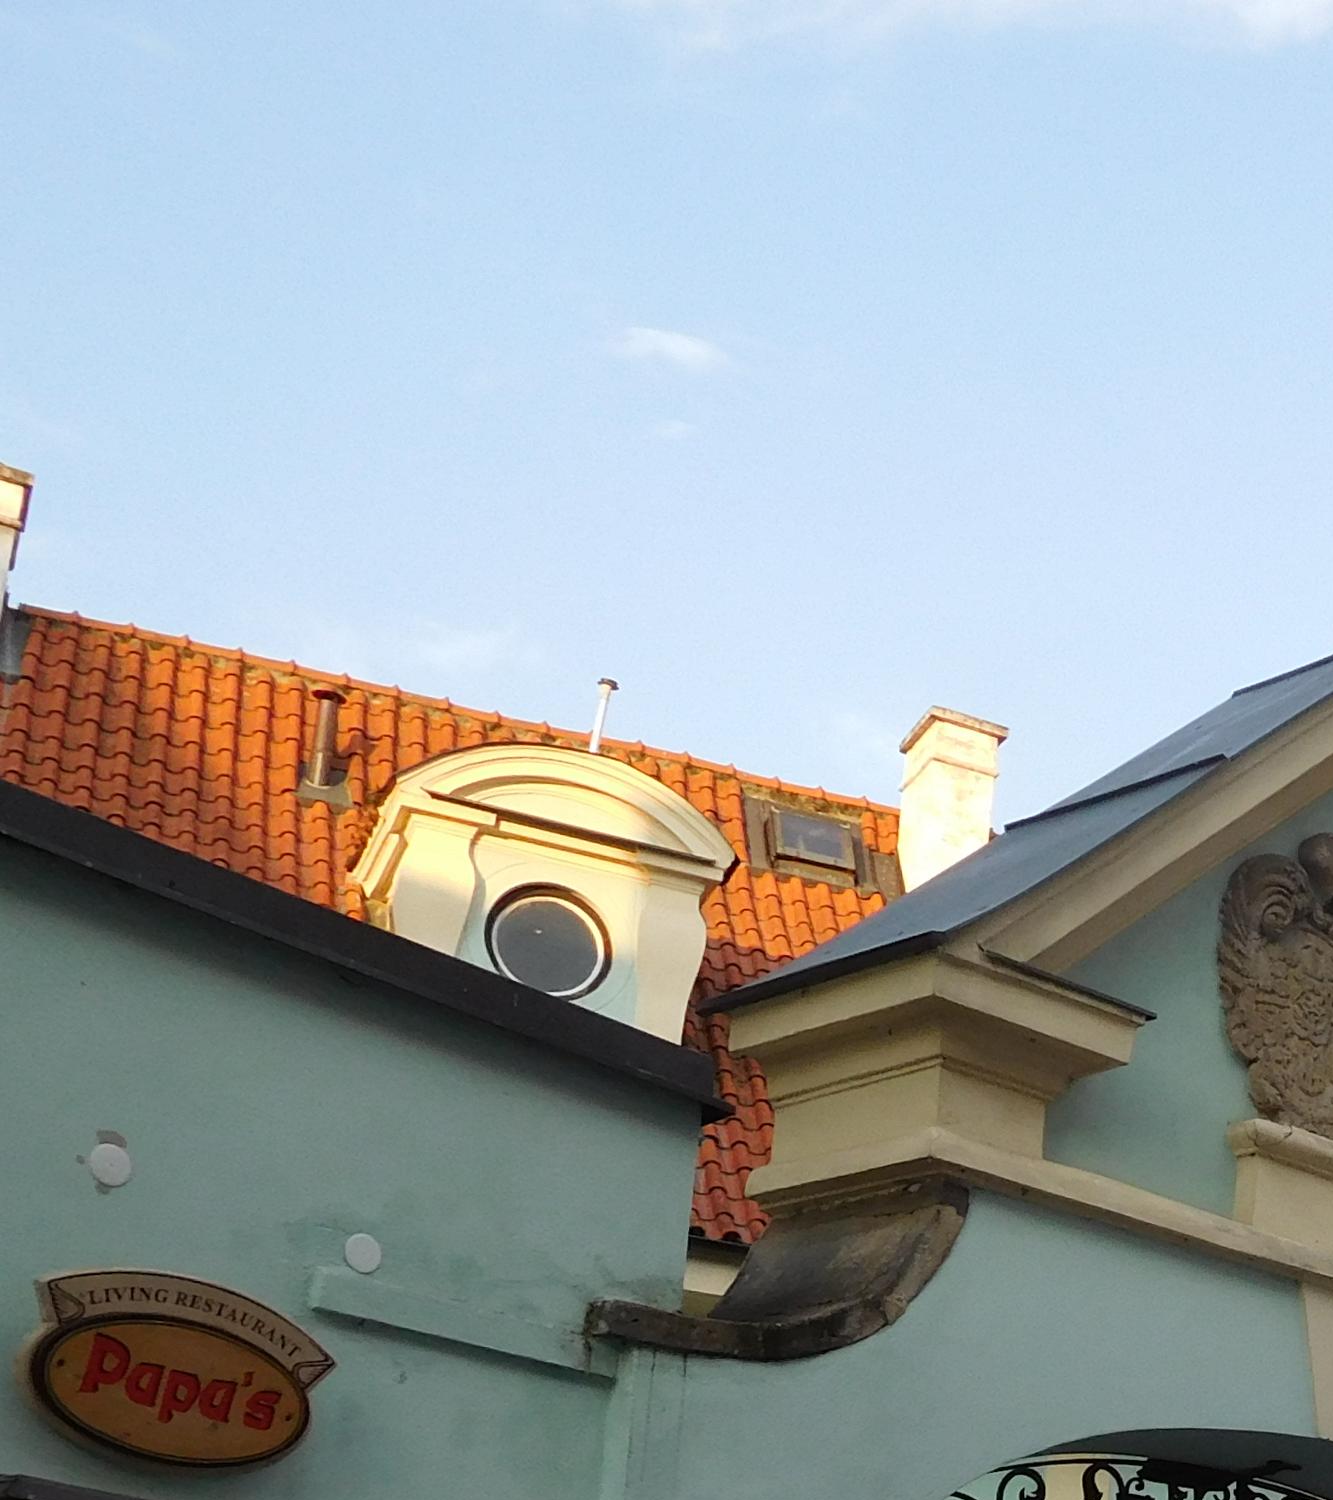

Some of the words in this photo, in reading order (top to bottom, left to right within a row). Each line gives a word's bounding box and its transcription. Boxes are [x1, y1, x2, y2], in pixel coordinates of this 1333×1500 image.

[87, 1286, 169, 1305] LIVING
[174, 1291, 303, 1358] RESTAURANT
[78, 1331, 282, 1431] Papa's
